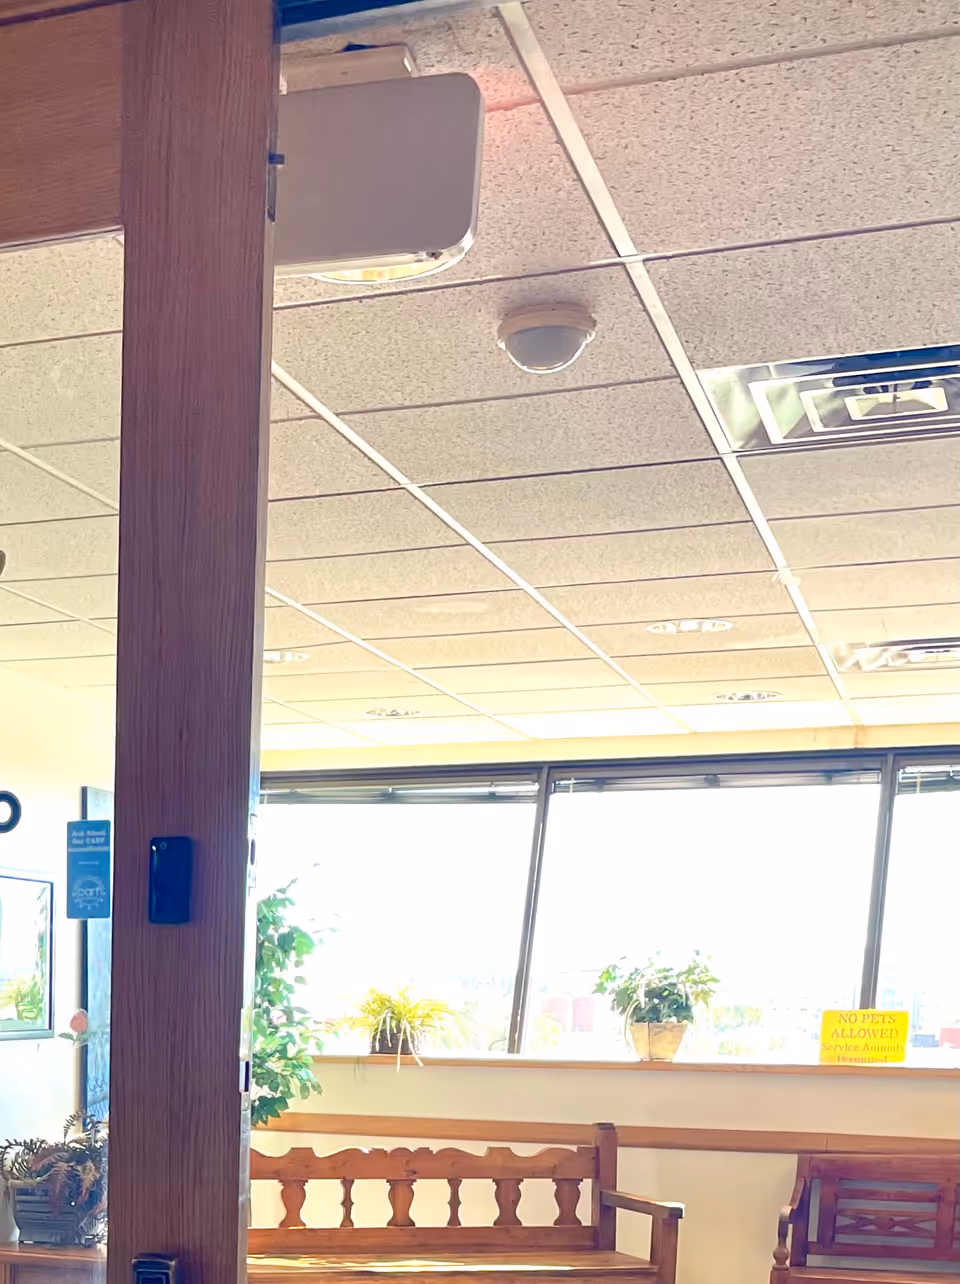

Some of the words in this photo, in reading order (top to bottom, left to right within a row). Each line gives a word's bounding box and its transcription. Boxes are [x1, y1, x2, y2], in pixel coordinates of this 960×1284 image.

[838, 1013, 858, 1024] NO
[862, 1013, 896, 1024] PETS
[831, 1028, 899, 1039] ALLOWED
[822, 1042, 860, 1052] Service
